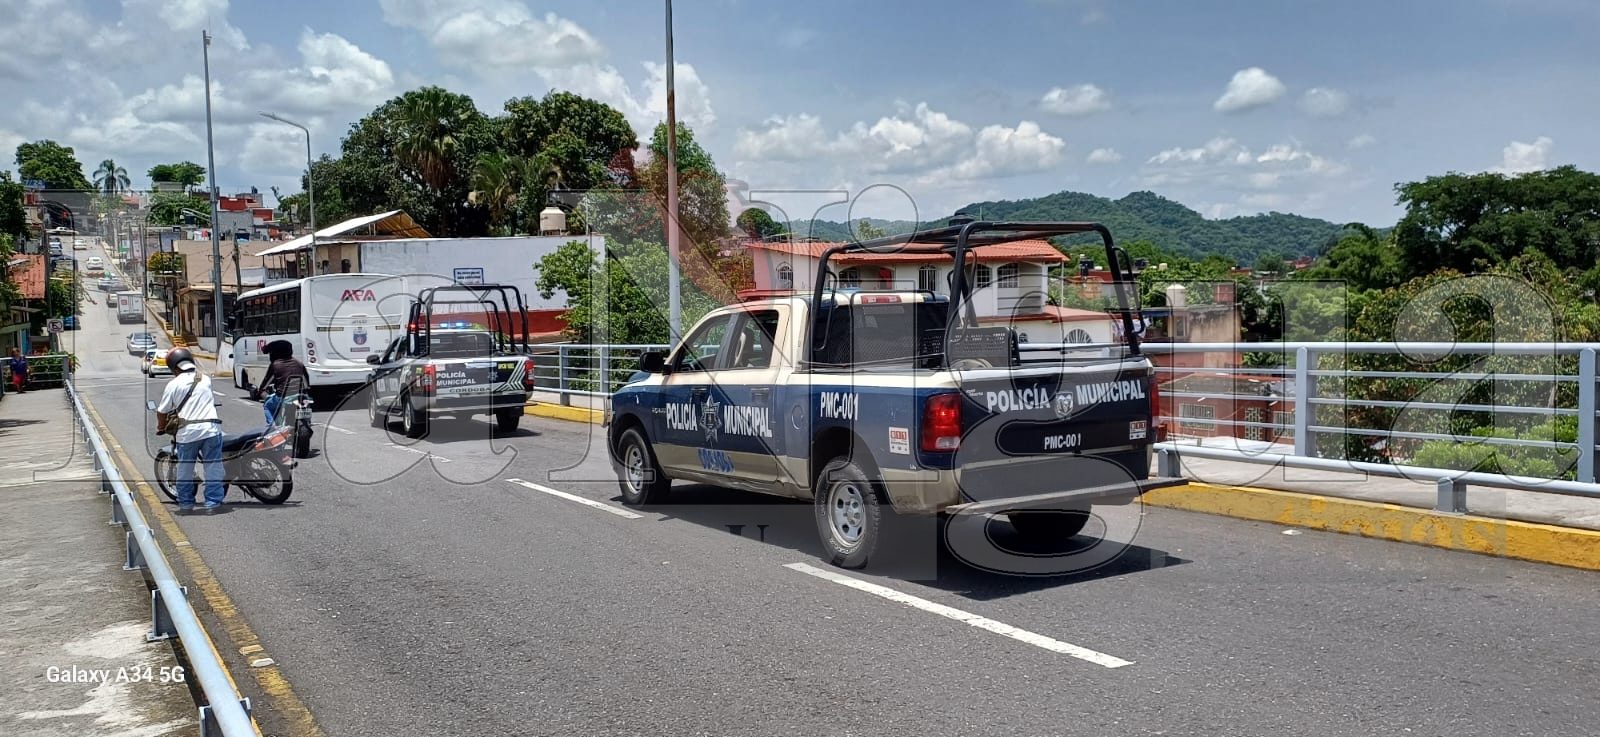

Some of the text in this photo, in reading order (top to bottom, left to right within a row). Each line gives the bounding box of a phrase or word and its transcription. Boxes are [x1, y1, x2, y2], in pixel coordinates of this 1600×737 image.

[436, 371, 466, 379] POLICÍA
[436, 378, 477, 387] MUNICIPAL
[820, 391, 859, 421] PMC-001
[986, 379, 1146, 413] POLICÍA MUNICIPAL
[666, 398, 773, 438] POLICÍA MUNICIPAL
[1044, 433, 1082, 450] PMC-001
